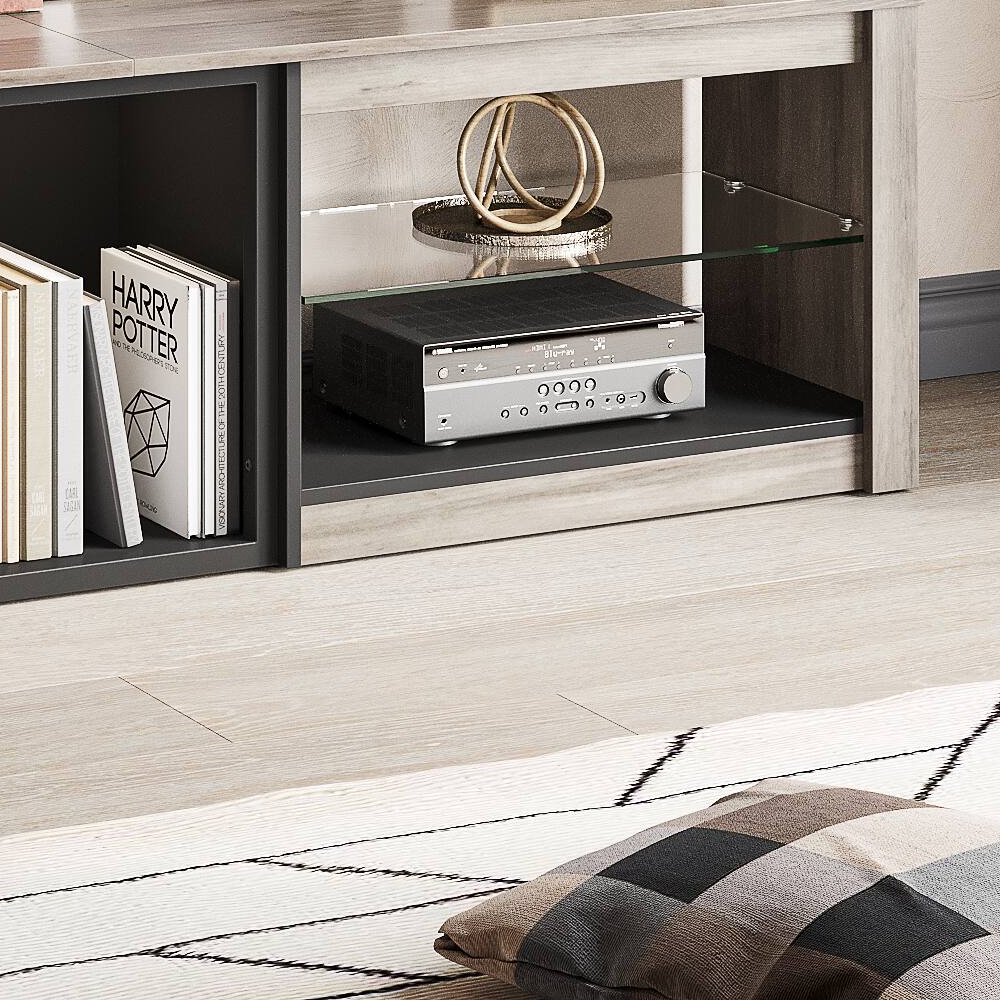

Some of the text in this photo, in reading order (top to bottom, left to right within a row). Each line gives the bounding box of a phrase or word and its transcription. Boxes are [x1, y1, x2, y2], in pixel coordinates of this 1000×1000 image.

[112, 270, 179, 329] HARRY
[112, 308, 178, 365] POTTER
[218, 334, 226, 376] CENTURY
[544, 349, 575, 359] Blu-ray
[218, 376, 226, 400] 20TH
[218, 418, 226, 430] OF
[218, 430, 226, 491] ARCHITECTURE
[218, 491, 226, 530] VISIONARY
